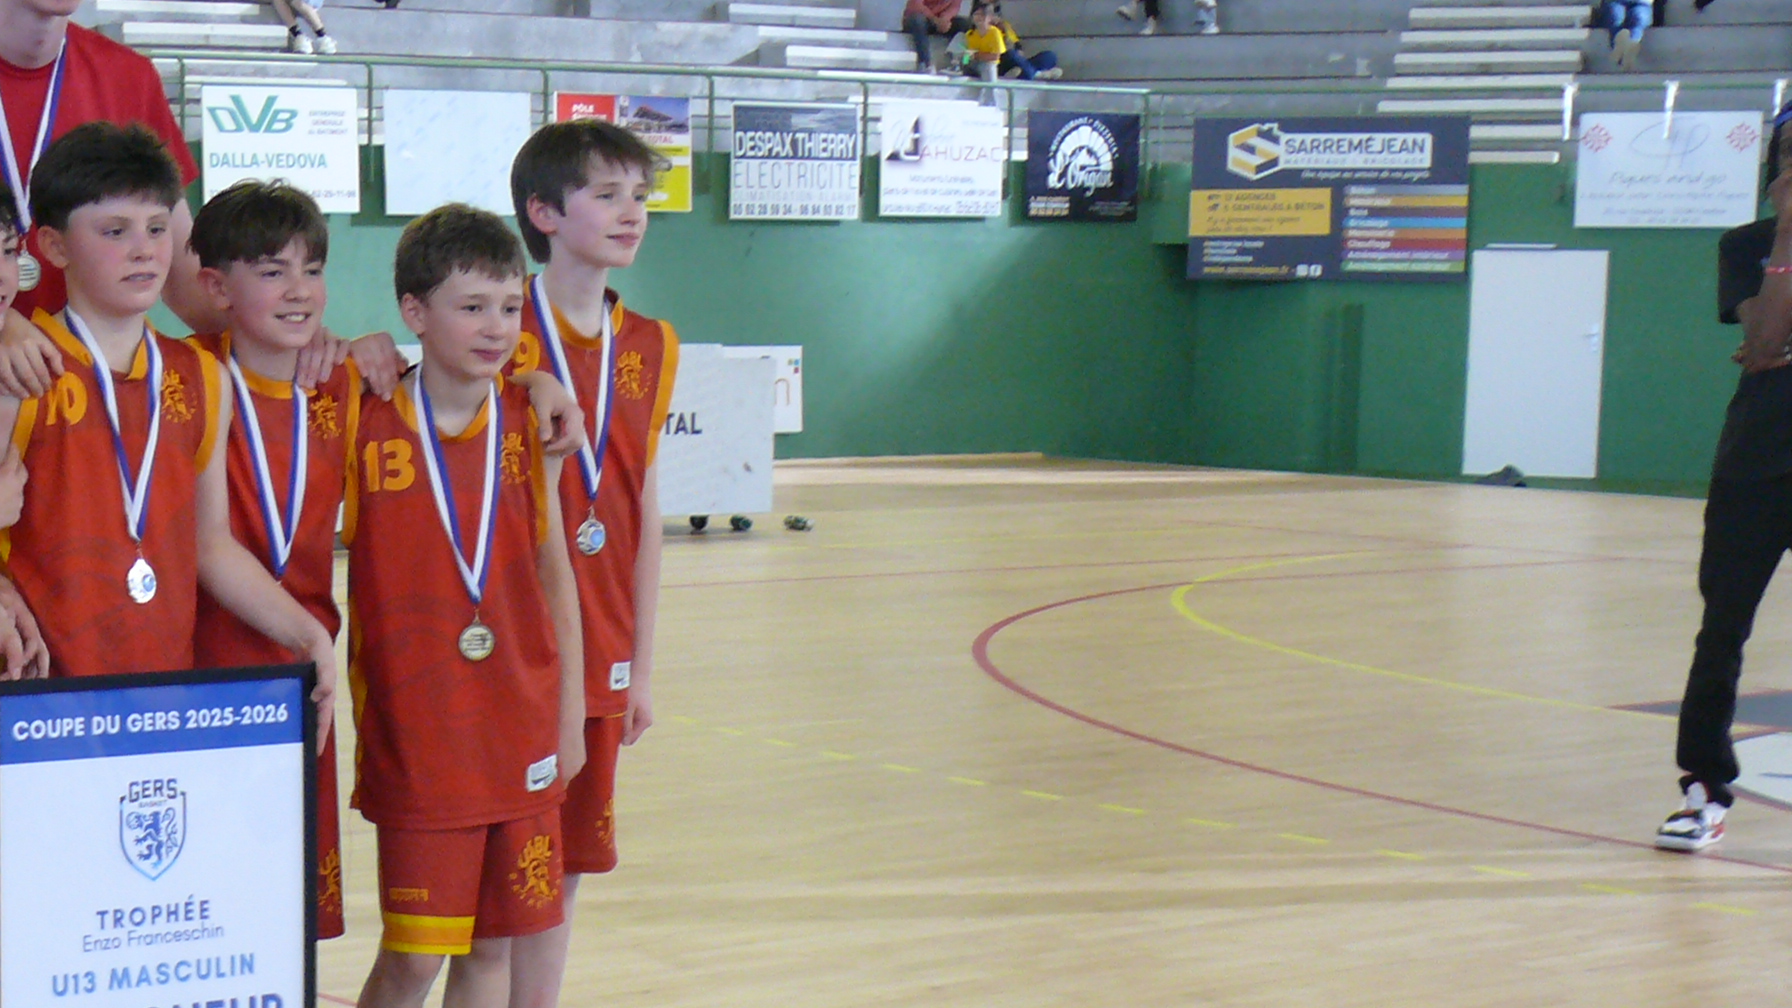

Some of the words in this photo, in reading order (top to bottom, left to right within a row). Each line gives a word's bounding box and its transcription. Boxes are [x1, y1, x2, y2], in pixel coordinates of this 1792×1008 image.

[206, 94, 299, 134] DVB
[735, 131, 795, 157] DESPAX
[794, 132, 857, 158] THIERRY
[1284, 135, 1426, 155] SARREMÉJEAN
[209, 152, 328, 169] DALLA-VEDOVA
[733, 161, 858, 190] ELECTRICITE
[361, 438, 415, 493] 13
[12, 715, 85, 742] COUPE
[91, 713, 121, 735] DU
[126, 710, 180, 733] GERS
[184, 703, 289, 730] 2025-2026
[128, 778, 178, 803] GERS
[95, 894, 211, 931] TROPHÉE
[82, 931, 122, 953] Enzo
[127, 922, 225, 949] Franceschin
[51, 973, 96, 998] U13
[108, 953, 256, 992] MASCULIN
